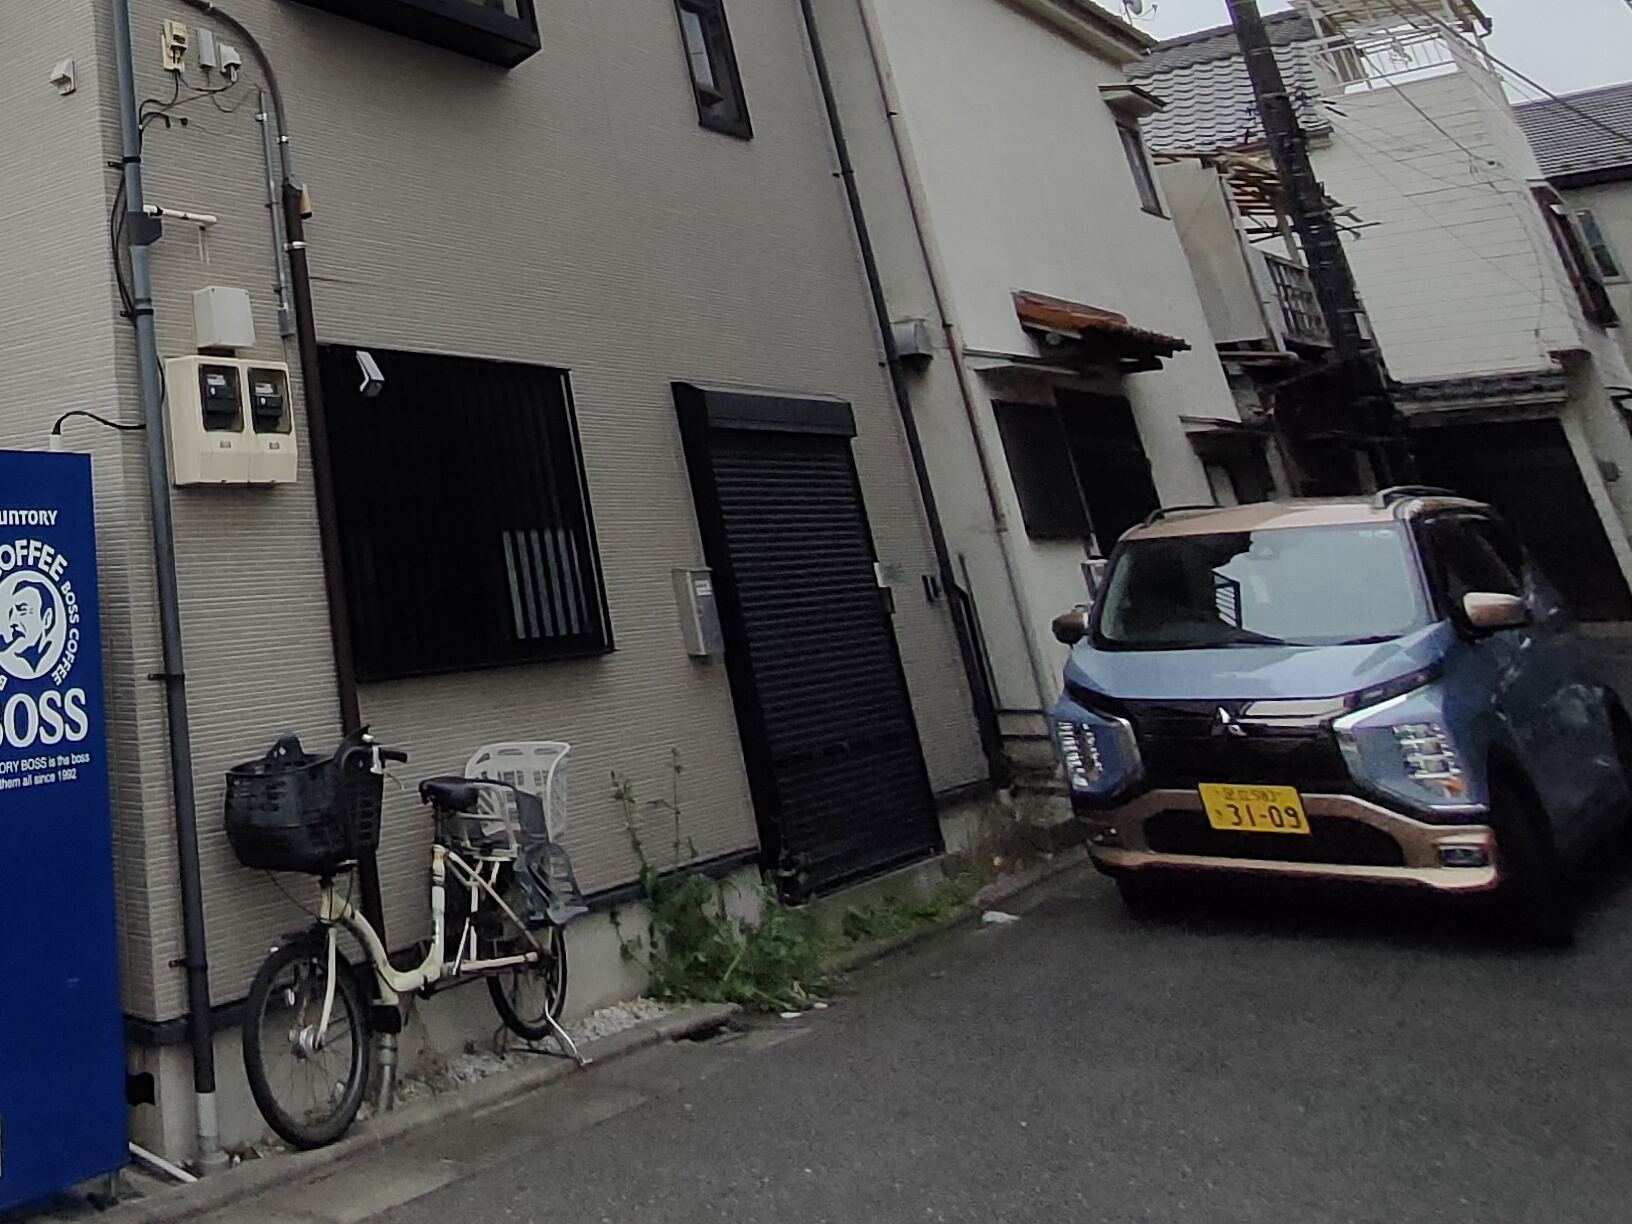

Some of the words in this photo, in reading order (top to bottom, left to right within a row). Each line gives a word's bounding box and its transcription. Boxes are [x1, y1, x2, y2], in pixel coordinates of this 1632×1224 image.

[60, 580, 80, 624] BOSS
[51, 627, 80, 686] COFFEE
[21, 756, 47, 772] BOSS
[48, 755, 56, 768] is
[57, 754, 70, 766] the
[71, 752, 90, 765] boss
[0, 776, 21, 790] them
[22, 773, 33, 787] all
[34, 771, 56, 785] since
[1225, 803, 1301, 829] 31-09
